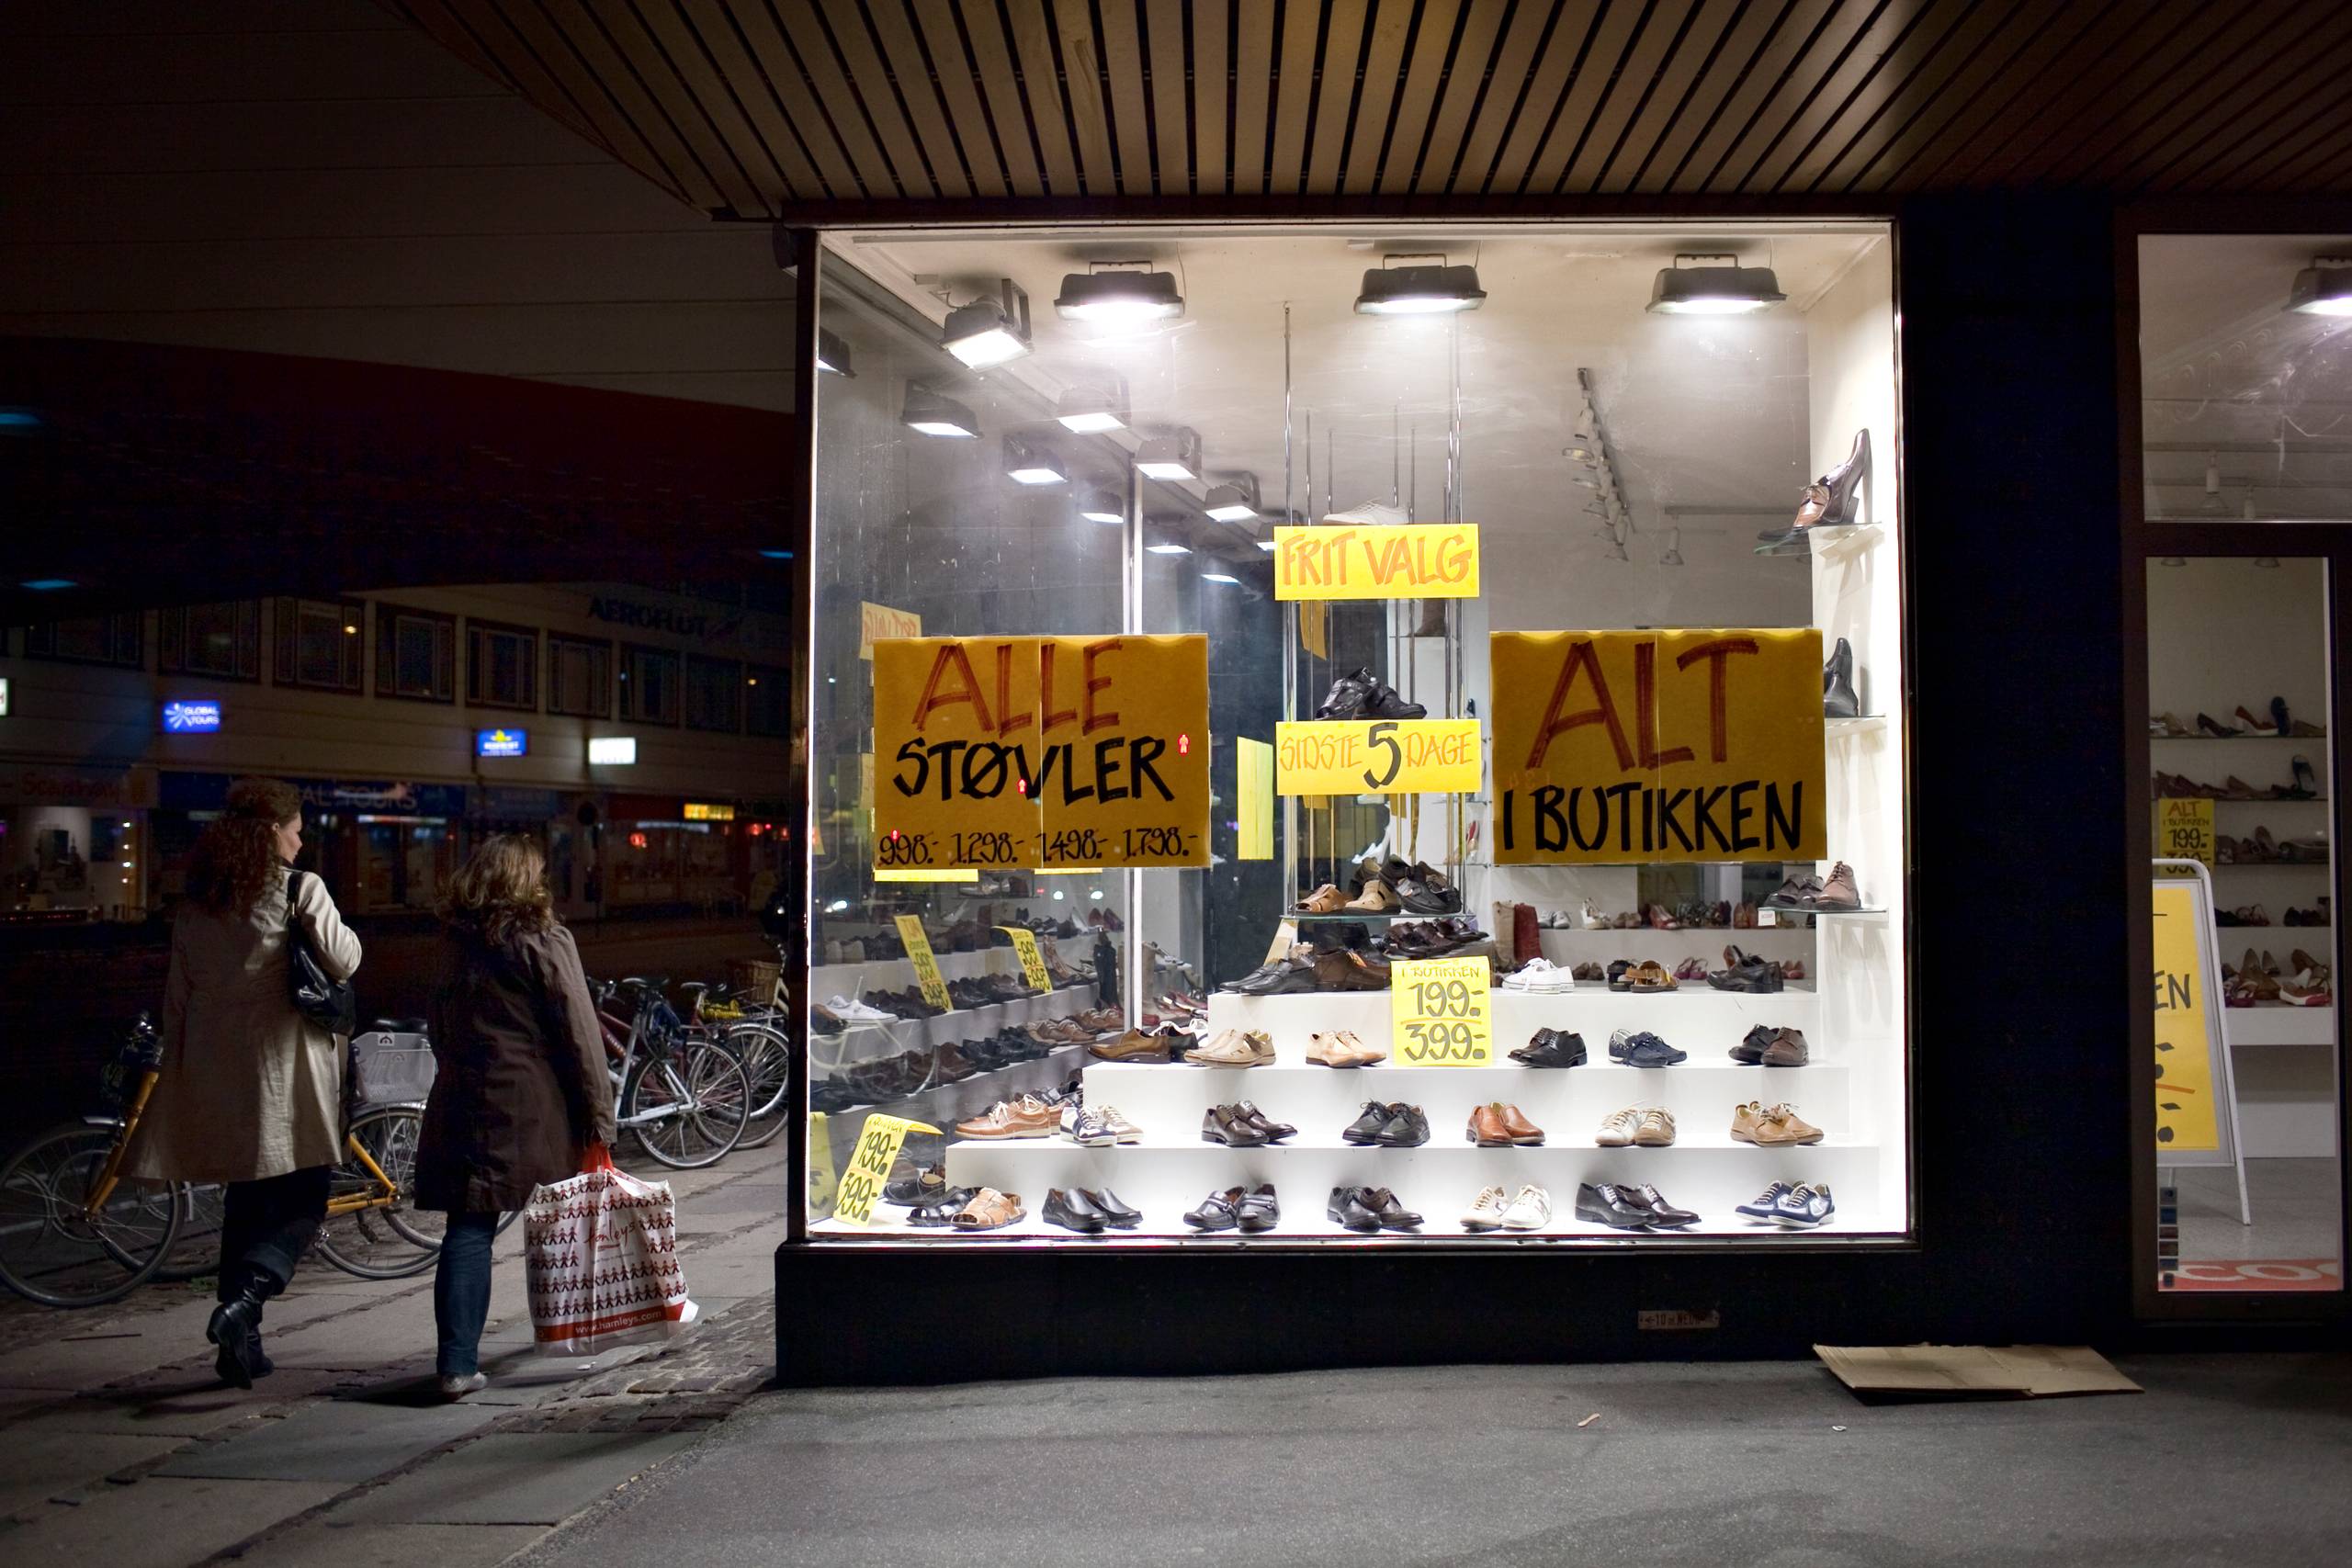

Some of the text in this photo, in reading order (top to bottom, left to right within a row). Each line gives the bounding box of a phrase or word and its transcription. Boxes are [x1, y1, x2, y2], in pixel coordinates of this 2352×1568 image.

[1282, 529, 1473, 587] FRIT VALG
[184, 706, 218, 716] GLOBAL
[911, 639, 1123, 739] ALLE
[1524, 637, 1759, 773] ALT
[892, 735, 1175, 806] STØVLER
[1279, 721, 1474, 789] SIDSTE 5 DAGE
[1503, 780, 1803, 853] I BUTIKKEN
[2167, 800, 2201, 818] ALT
[1412, 966, 1480, 978] BUTIKKEN
